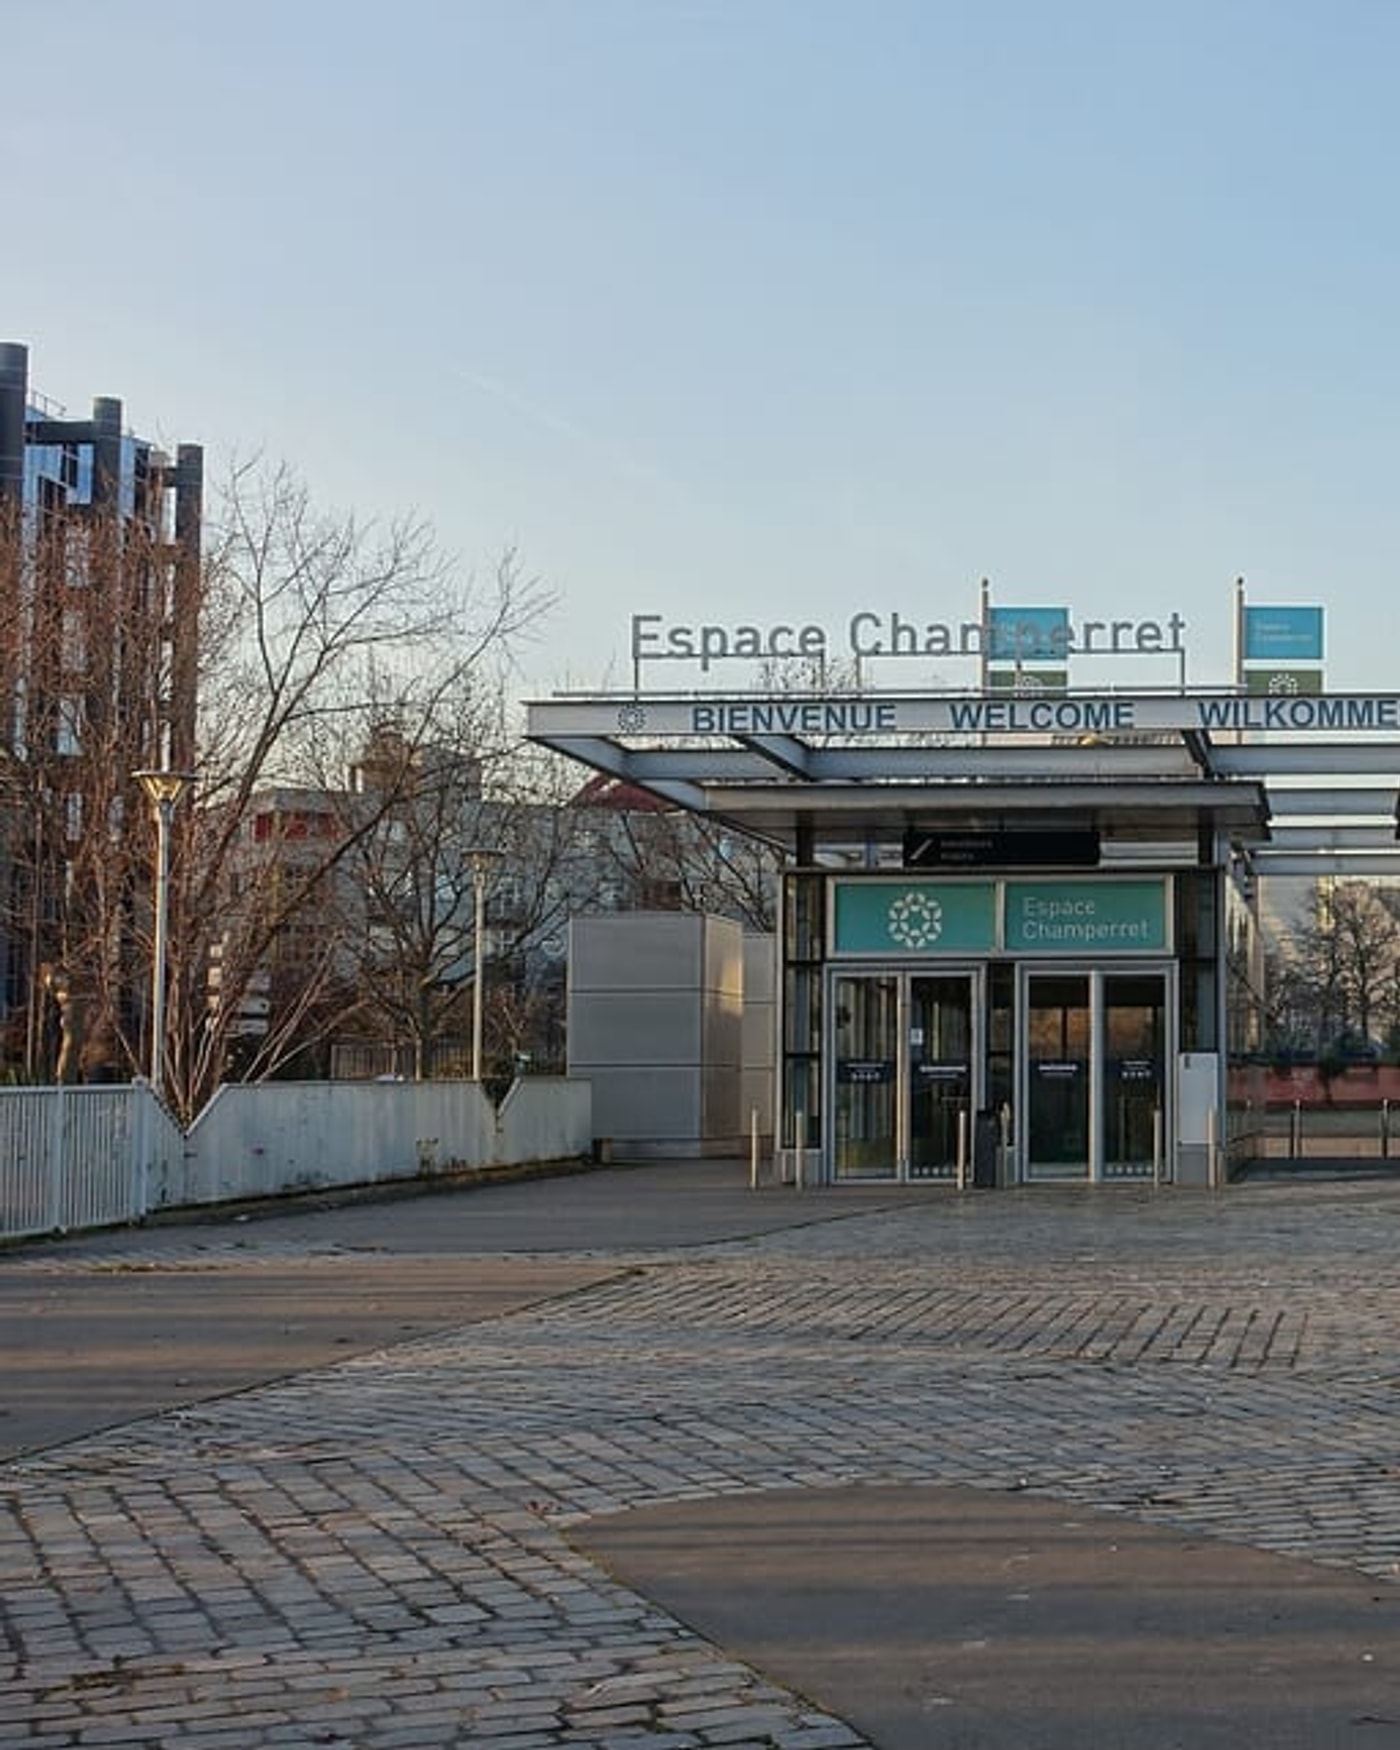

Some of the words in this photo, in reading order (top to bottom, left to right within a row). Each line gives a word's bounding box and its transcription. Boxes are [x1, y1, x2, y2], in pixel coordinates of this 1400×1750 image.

[632, 614, 826, 672] Espace
[693, 704, 897, 732] BIENVENUE
[949, 702, 1134, 730] WELCOME
[1022, 897, 1096, 918] Espace
[1022, 919, 1149, 942] Champerret
